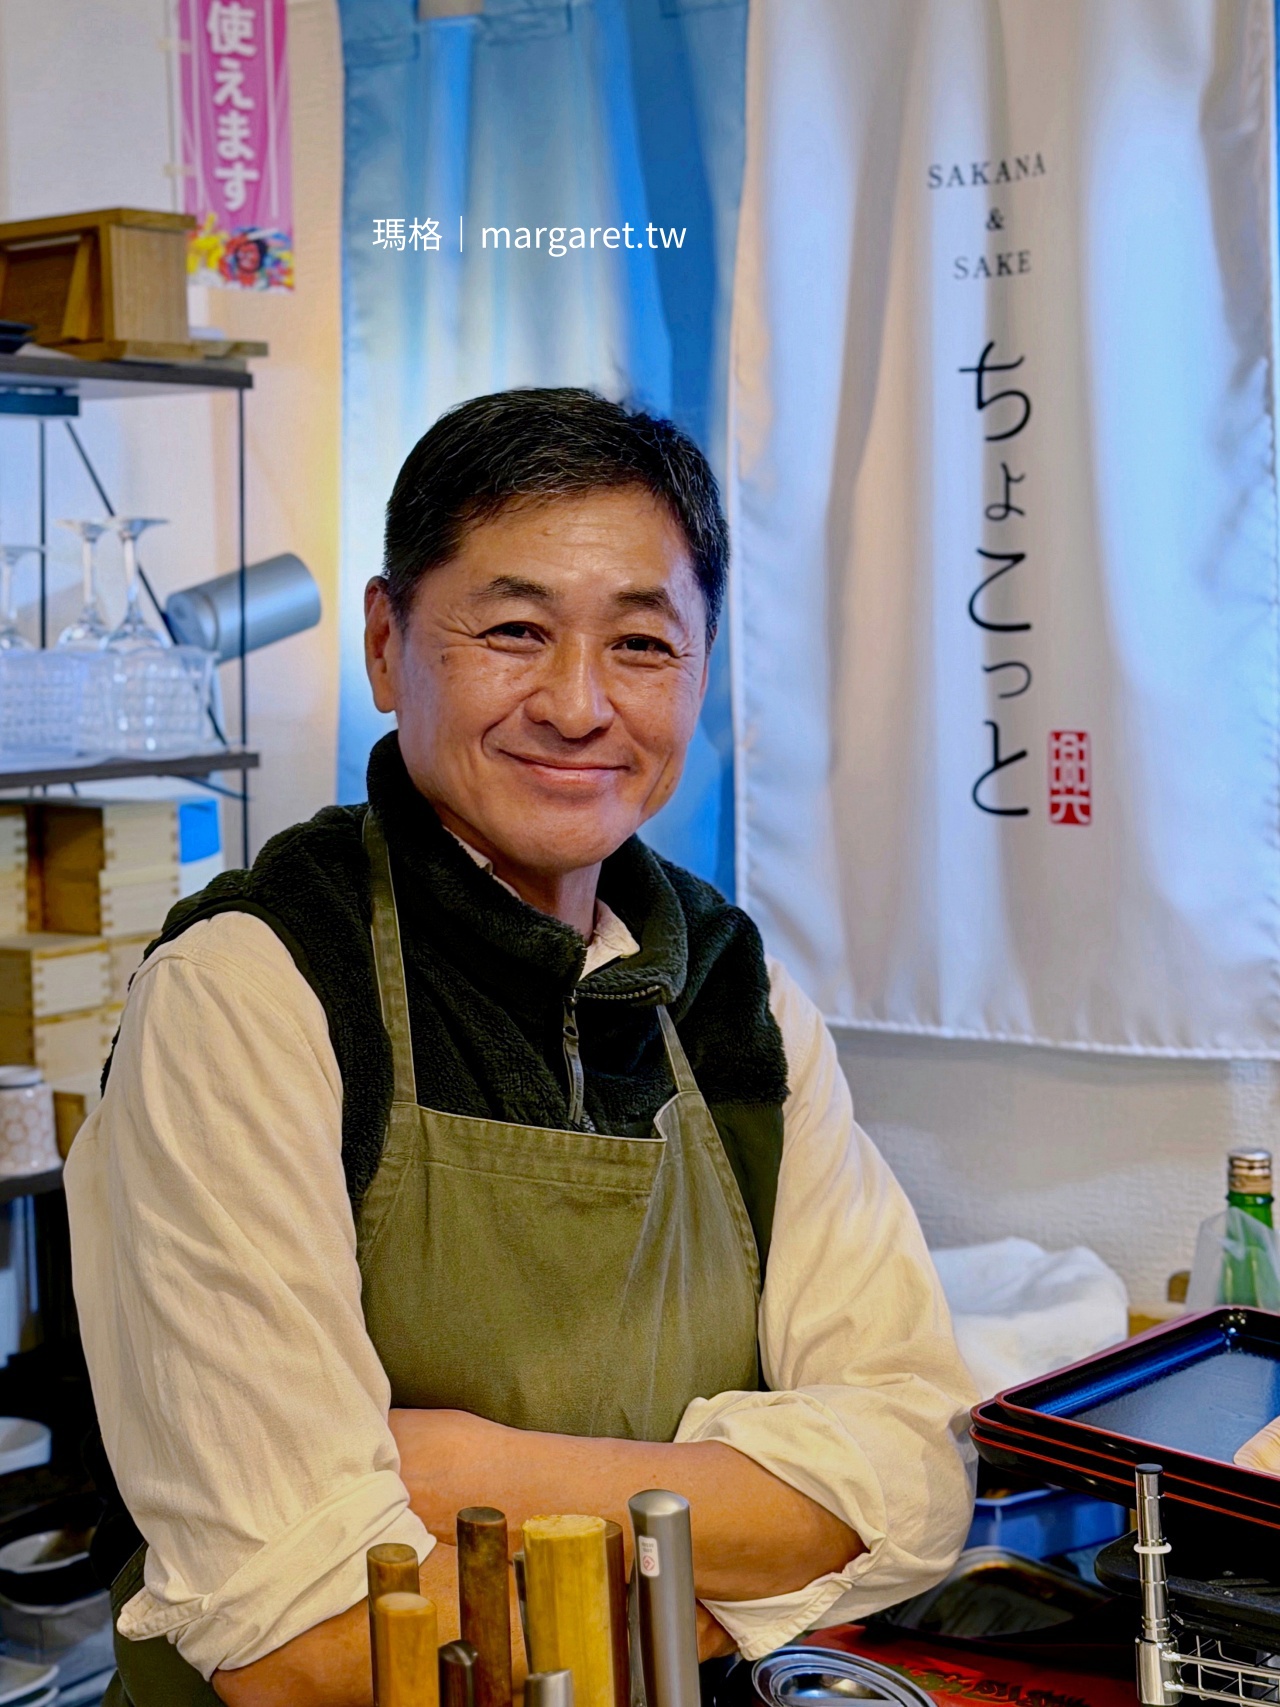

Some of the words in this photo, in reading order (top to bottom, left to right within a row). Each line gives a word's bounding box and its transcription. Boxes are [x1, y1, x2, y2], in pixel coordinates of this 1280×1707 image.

[206, 1, 260, 211] 使えます
[927, 153, 1046, 189] SAKANA
[985, 207, 1004, 231] &
[953, 250, 1031, 280] SAKE
[958, 340, 1032, 816] ちょこっと
